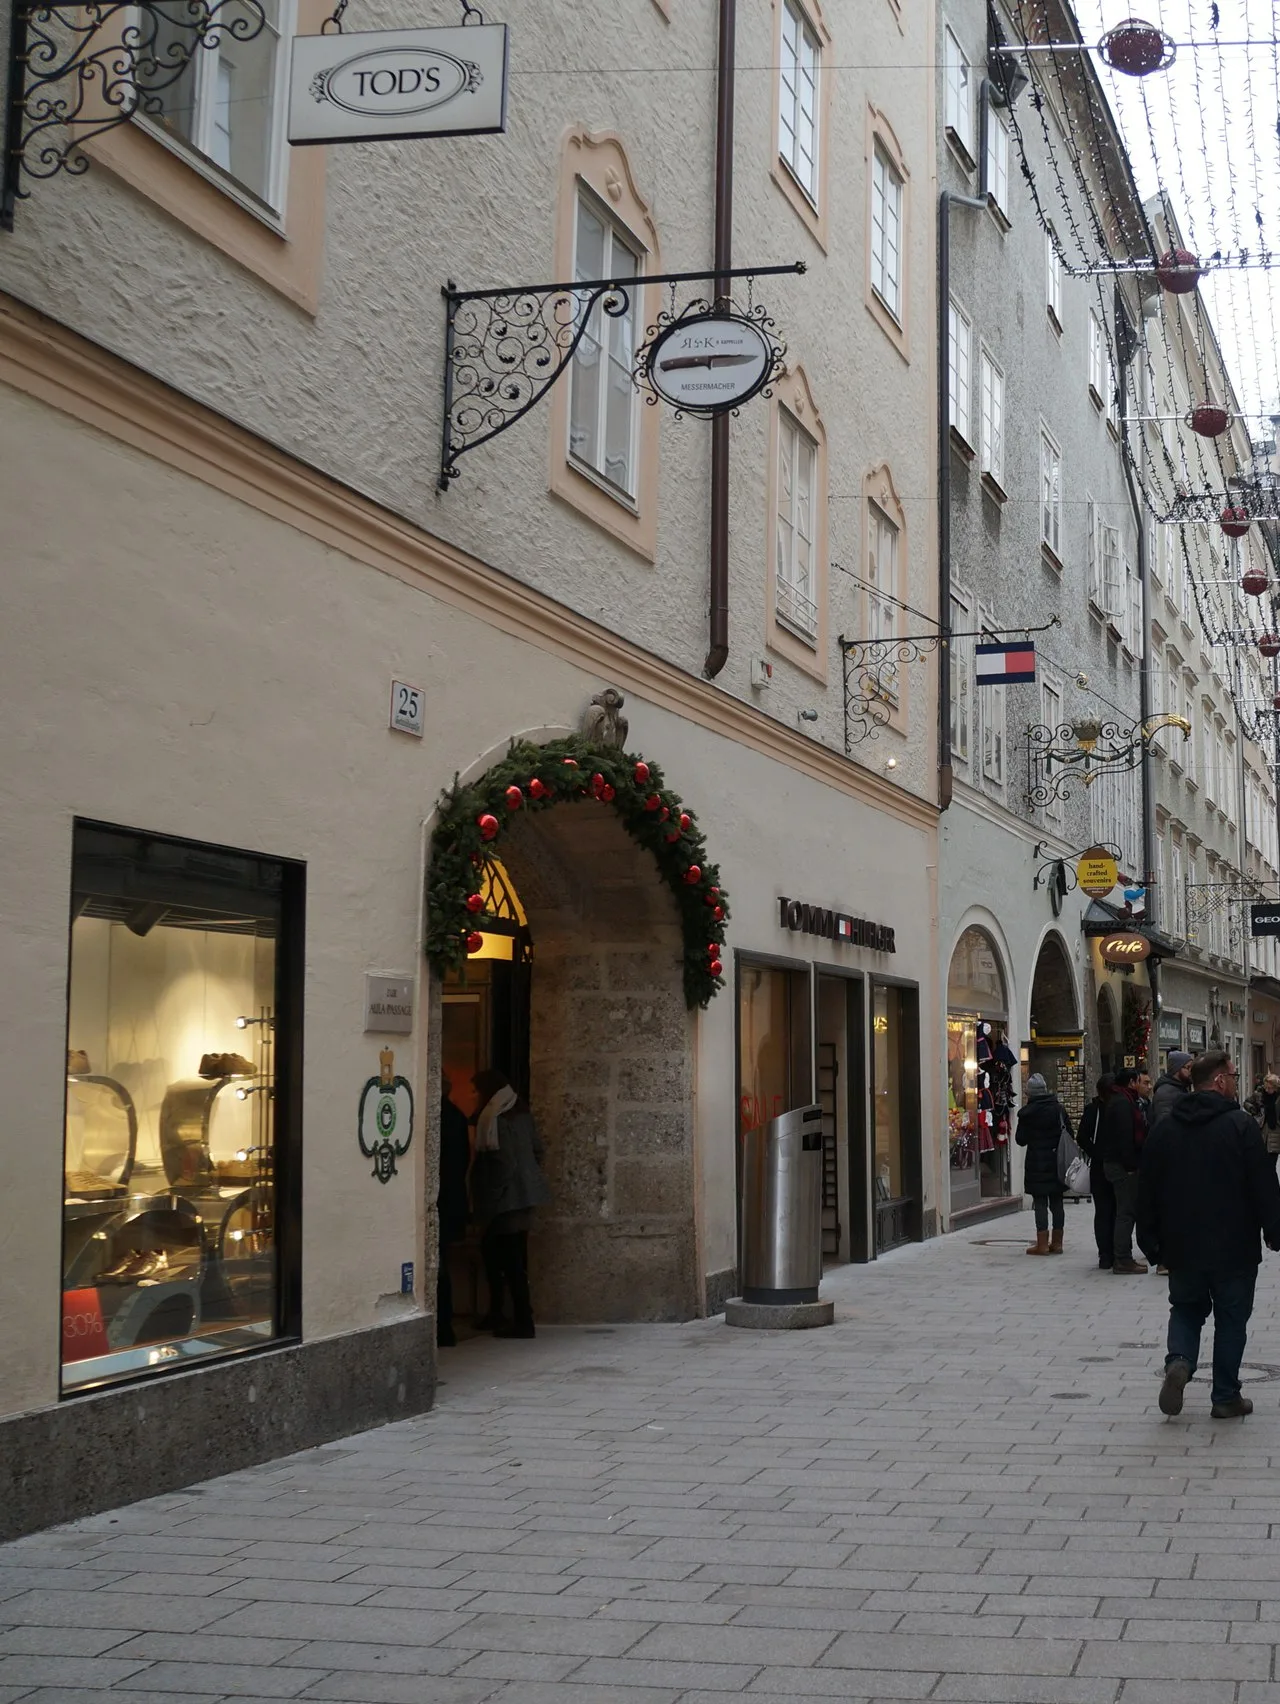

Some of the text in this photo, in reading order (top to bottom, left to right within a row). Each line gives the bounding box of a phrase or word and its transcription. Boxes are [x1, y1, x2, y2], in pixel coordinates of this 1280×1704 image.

[352, 67, 440, 96] TOD'S
[681, 382, 736, 391] MESSERMACHER
[399, 688, 419, 718] 25
[1106, 940, 1143, 954] Café
[62, 1312, 104, 1338] 30%
